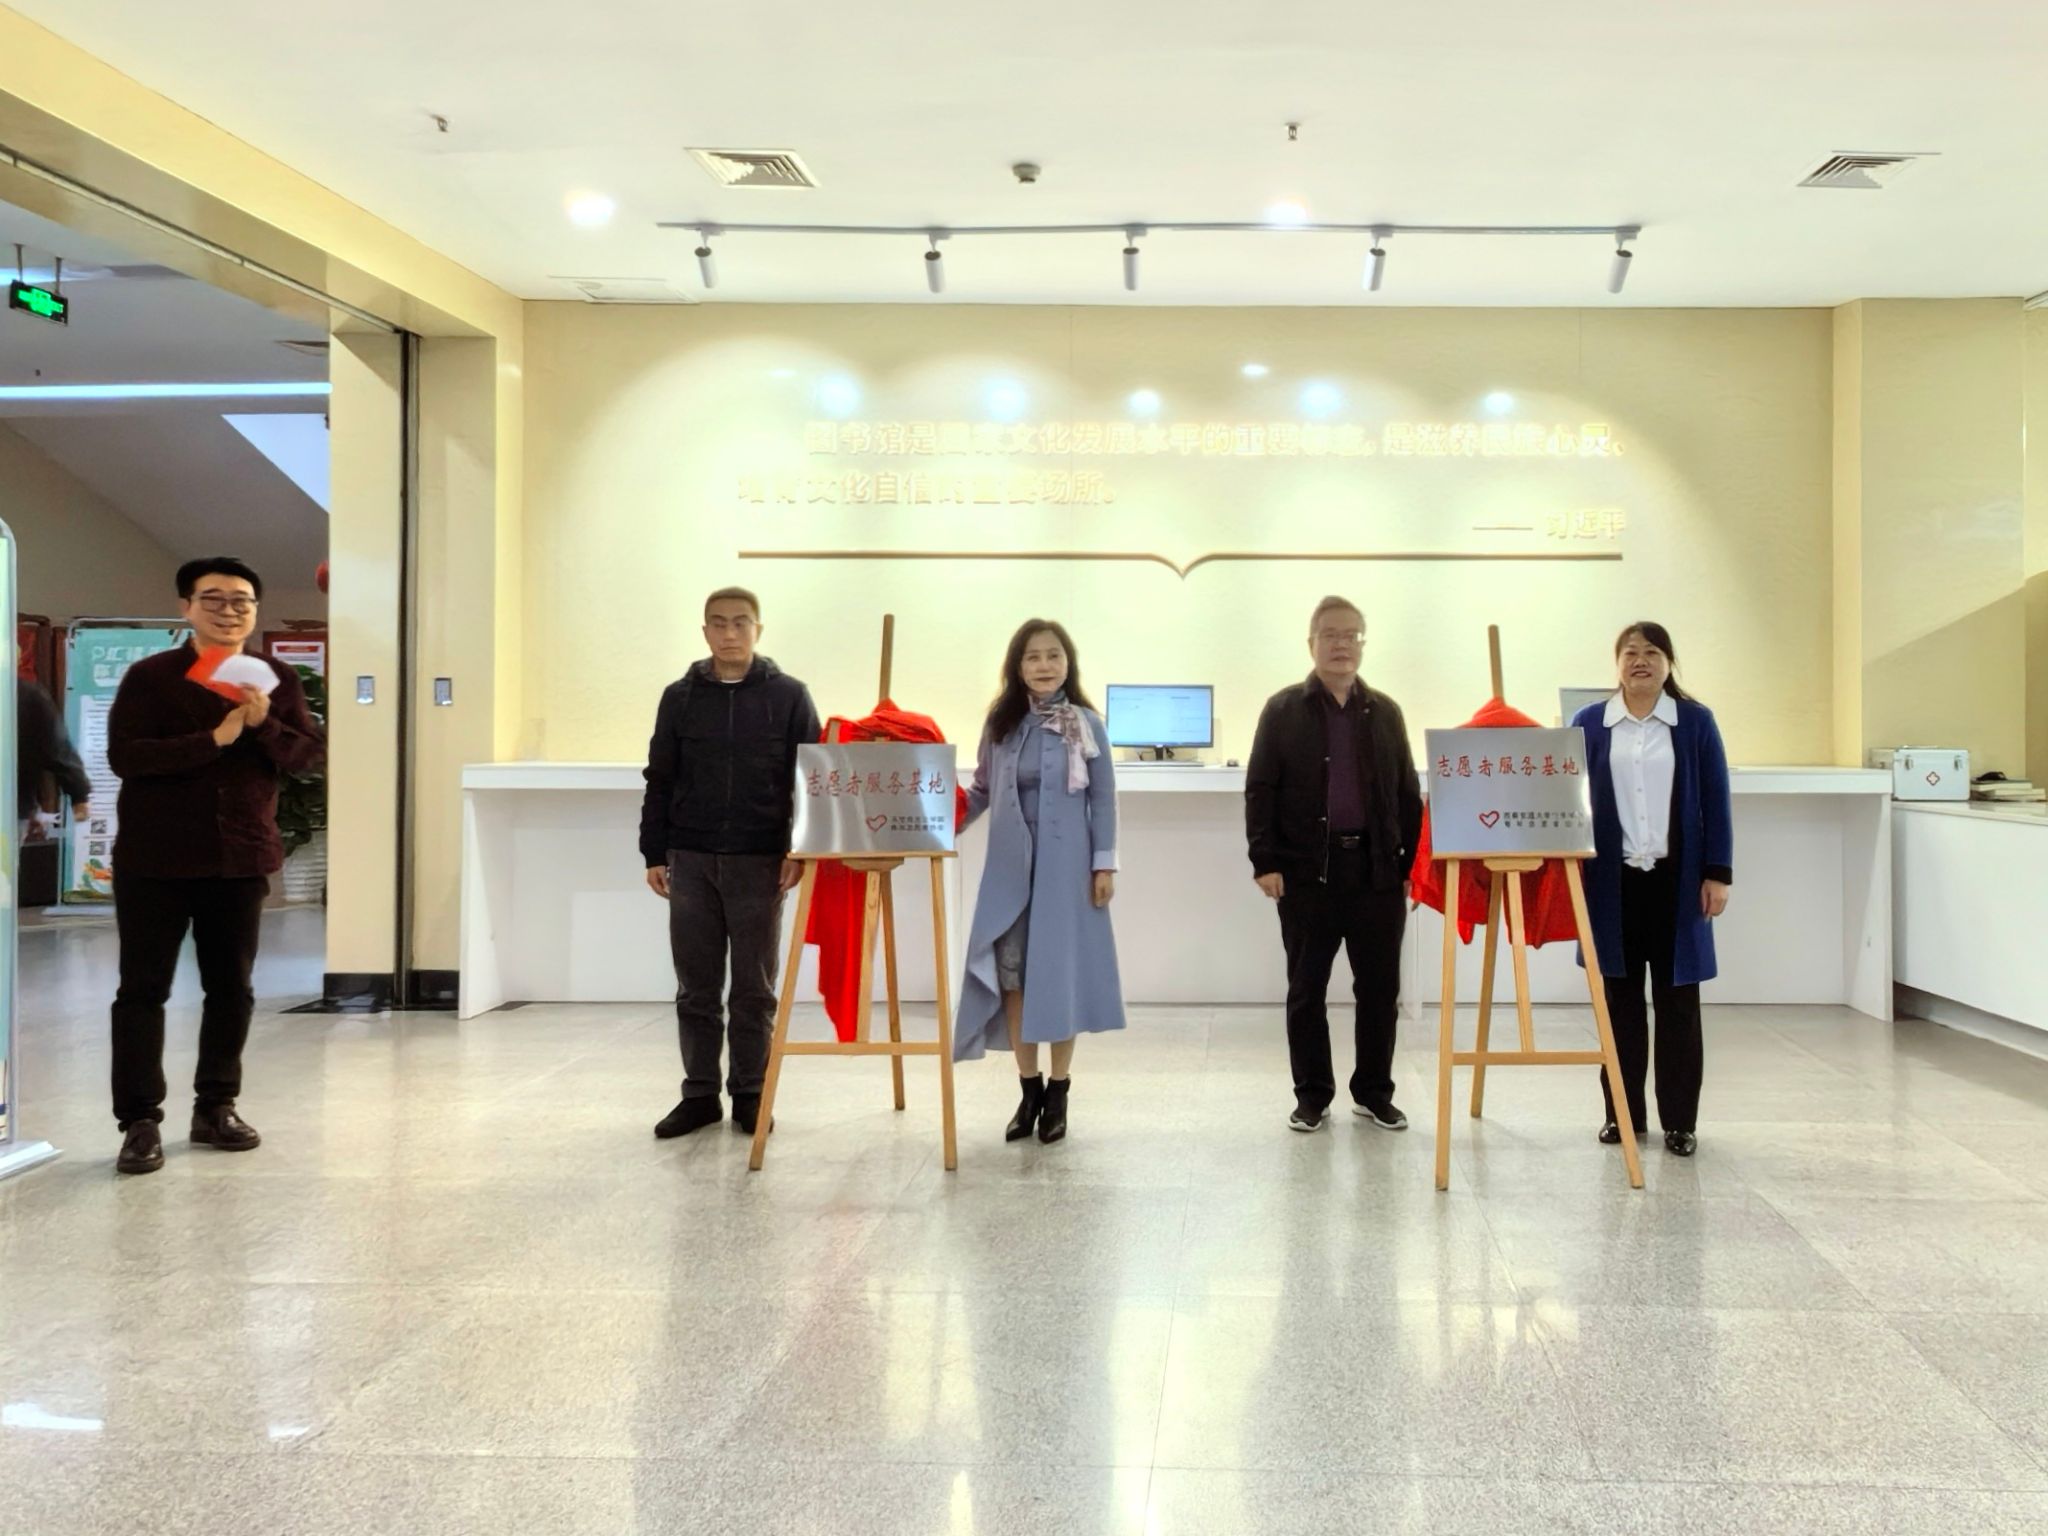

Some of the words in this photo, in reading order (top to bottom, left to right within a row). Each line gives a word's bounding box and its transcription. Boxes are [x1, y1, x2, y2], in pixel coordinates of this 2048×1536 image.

[1436, 754, 1580, 778] 志愿者服务基地
[806, 768, 946, 797] 志愿者服务基地
